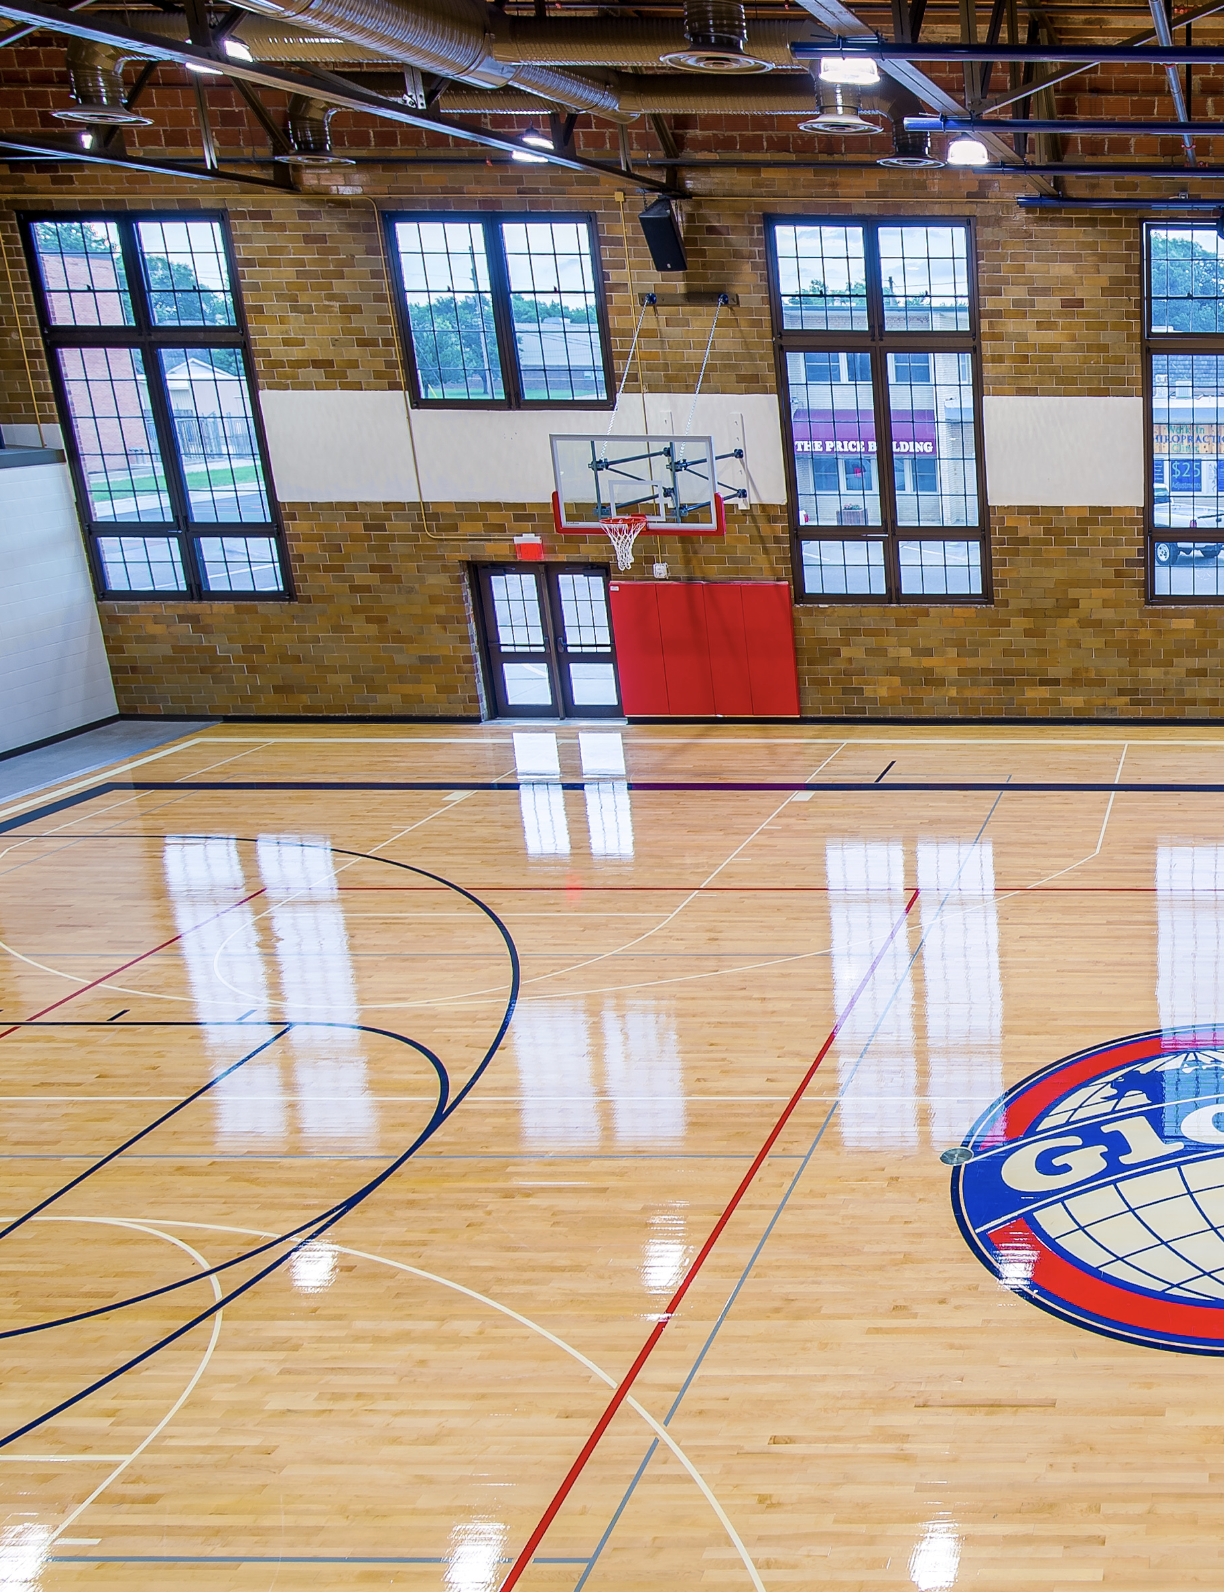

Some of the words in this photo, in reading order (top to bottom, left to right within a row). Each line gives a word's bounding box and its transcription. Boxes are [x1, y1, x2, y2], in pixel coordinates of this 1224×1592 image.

[795, 441, 823, 452] THE
[825, 441, 865, 452] PRICE
[867, 441, 934, 453] BLDING
[1171, 443, 1200, 453] Clinc
[1172, 461, 1201, 478] $25
